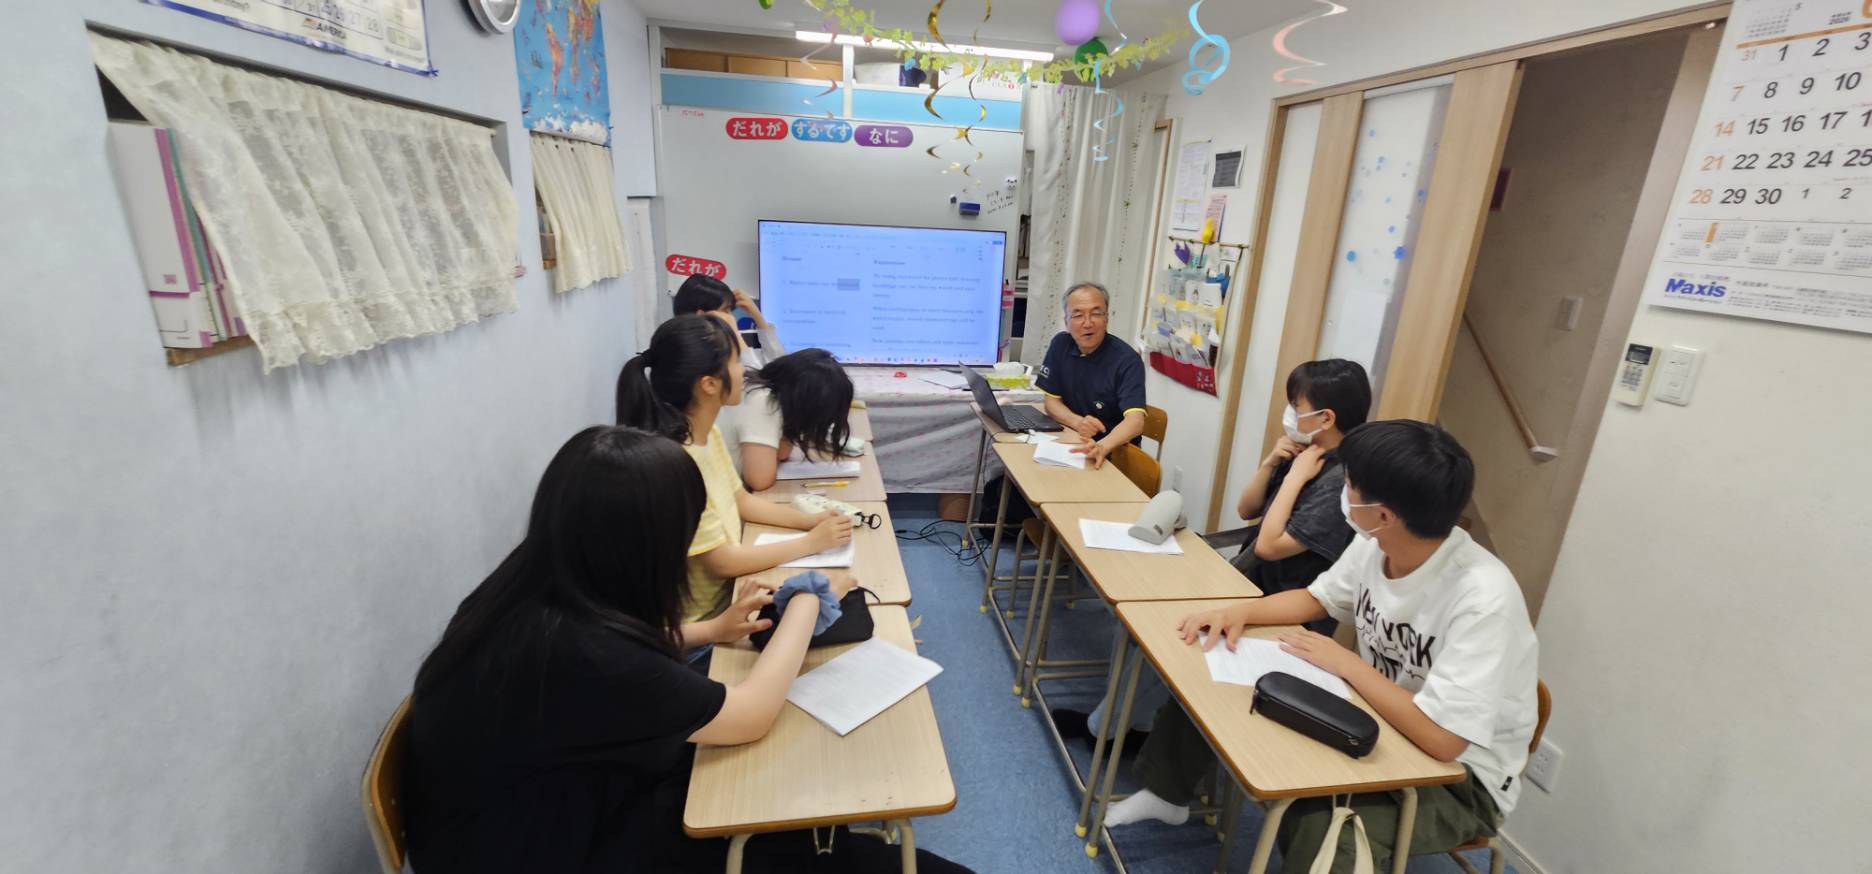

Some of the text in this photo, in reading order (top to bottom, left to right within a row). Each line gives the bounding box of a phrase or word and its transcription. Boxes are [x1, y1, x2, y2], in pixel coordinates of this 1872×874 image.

[1742, 32, 1871, 61] 31 1 2 3
[1730, 71, 1862, 102] 7 8 9 10
[732, 120, 782, 137] だれが
[869, 127, 899, 144] なに
[1714, 109, 1872, 137] 14 15 16 17 1
[1700, 148, 1872, 171] 21 22 23 24 25
[1689, 187, 1853, 205] 28 29 30 1 2
[671, 257, 721, 276] だれが
[1664, 277, 1727, 298] Maxis
